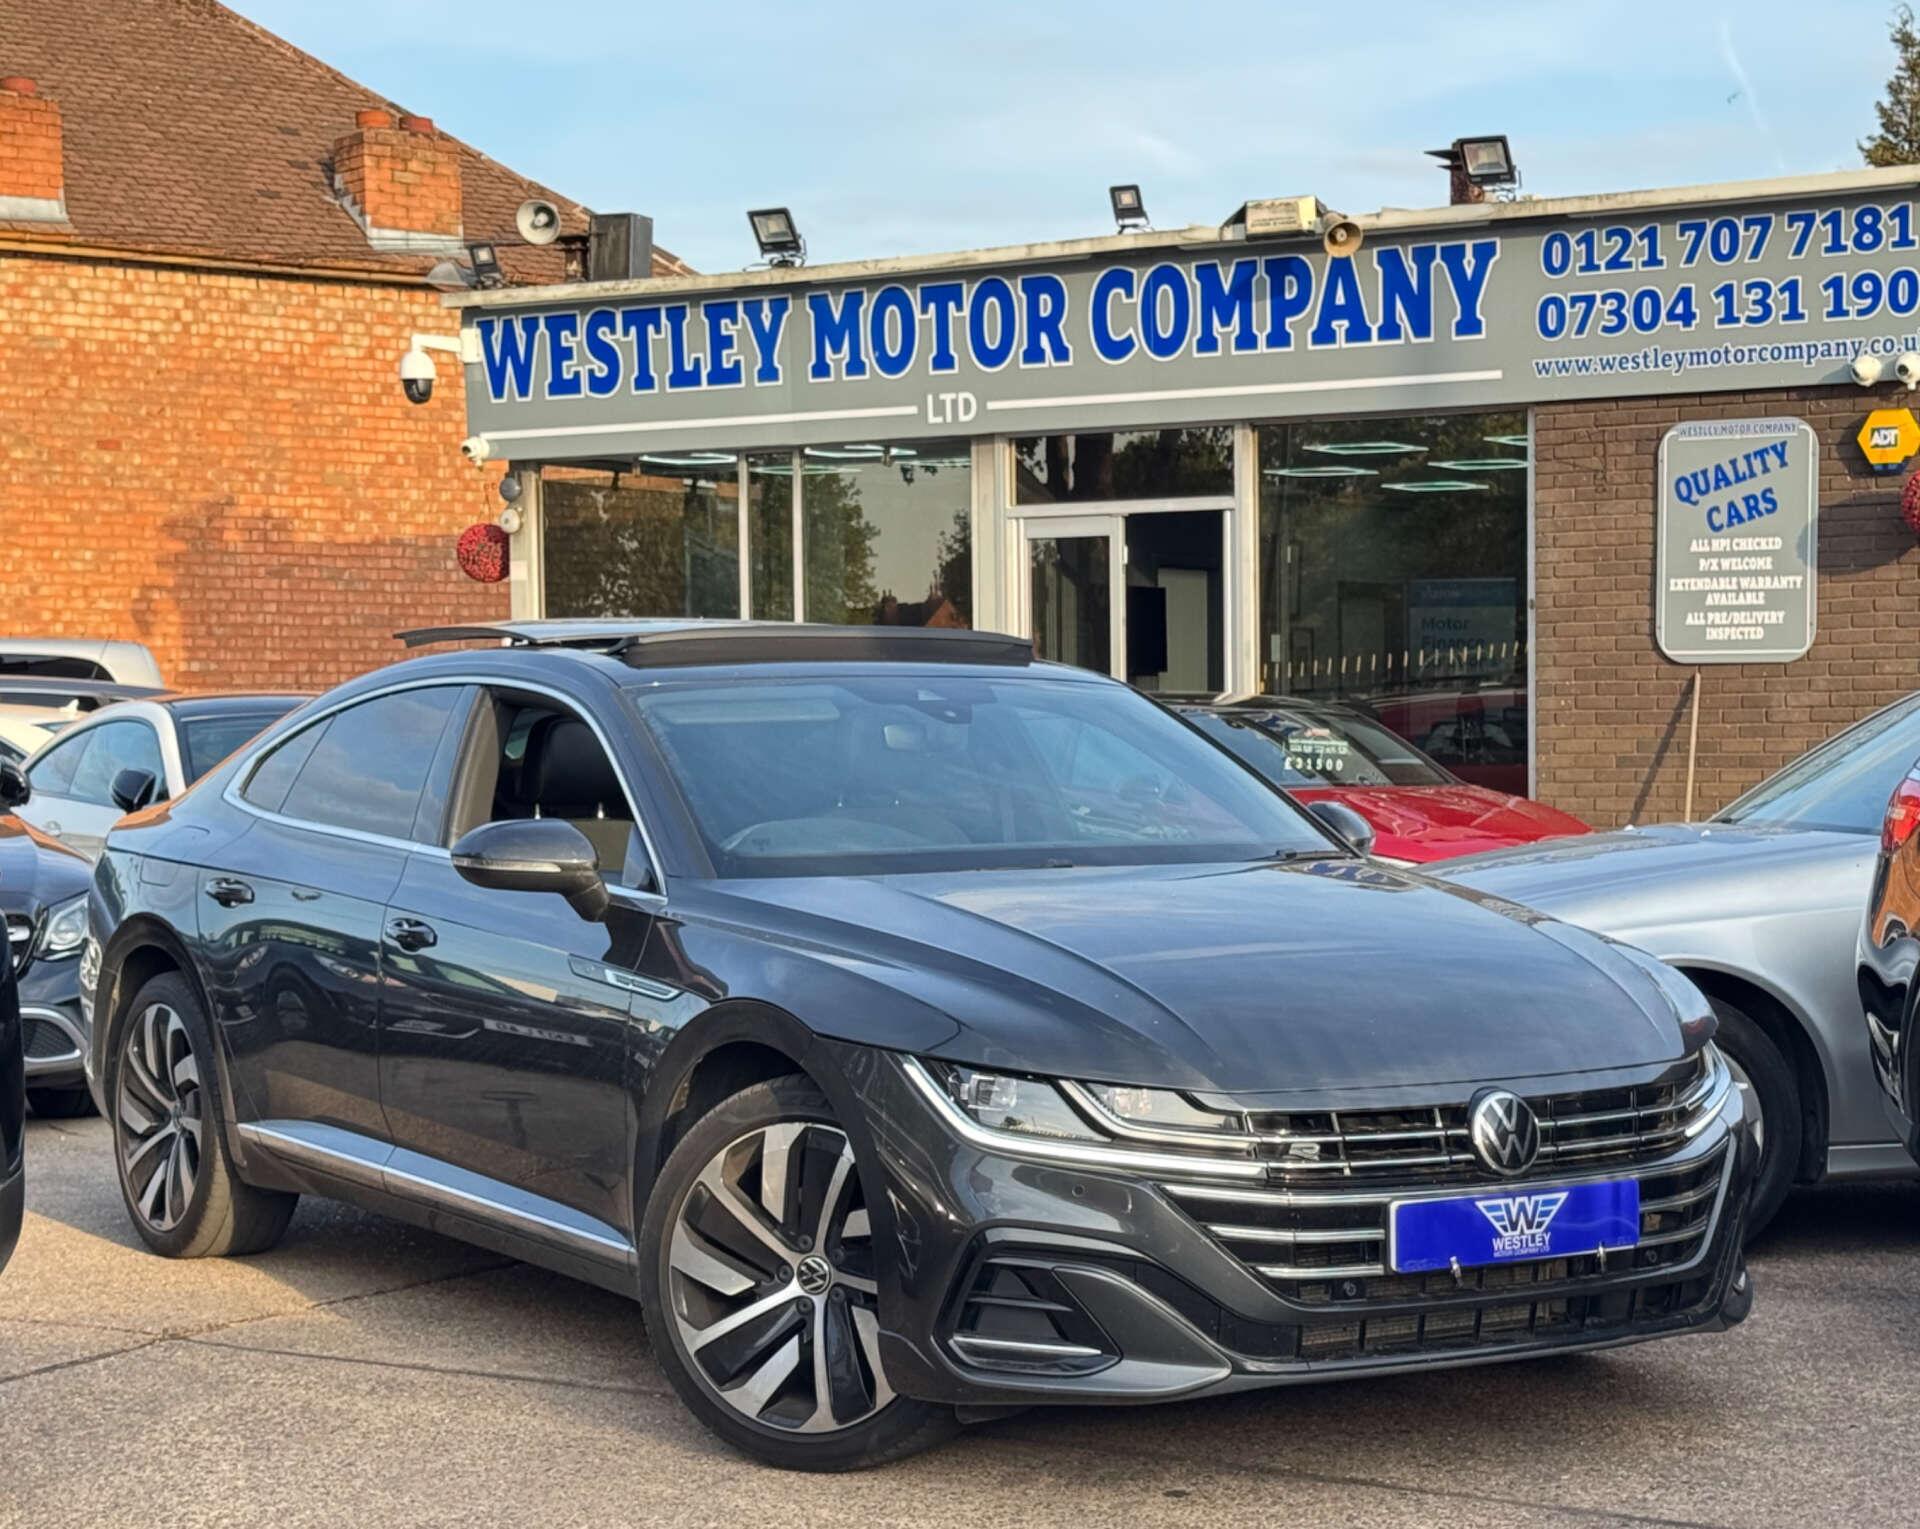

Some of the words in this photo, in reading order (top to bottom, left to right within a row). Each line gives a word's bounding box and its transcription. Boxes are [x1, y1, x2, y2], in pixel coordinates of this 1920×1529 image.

[1541, 222, 1666, 279] 0121
[1676, 212, 1775, 268] 707
[1785, 201, 1918, 260] 7181
[1537, 283, 1699, 342] 07304
[1711, 274, 1808, 329] 131
[1820, 266, 1920, 320] 190
[474, 294, 791, 402] WESTLEY
[805, 272, 1072, 383] MOTOR
[1089, 238, 1501, 365] COMPANY
[1534, 329, 1920, 378] www.westleymotorcompany.co.u
[926, 392, 977, 424] LTD
[1720, 424, 1751, 436] MOTOR
[1753, 422, 1796, 434] COMPANY
[1870, 428, 1899, 447] ADT
[1674, 440, 1789, 507] QUALITY
[1706, 487, 1778, 533] CARS
[1690, 538, 1710, 552] ALL
[1732, 537, 1782, 551] CHECKED
[1699, 557, 1719, 571] P/X
[1720, 556, 1773, 571] WELCOME
[1669, 577, 1739, 591] EXTENDABLE
[1740, 575, 1803, 590] WARRANTY
[1705, 591, 1765, 606] AVAILABLE
[1685, 612, 1705, 625] ALL
[1705, 626, 1764, 640] INSPECTED
[1492, 1231, 1551, 1251] WESTLEY
